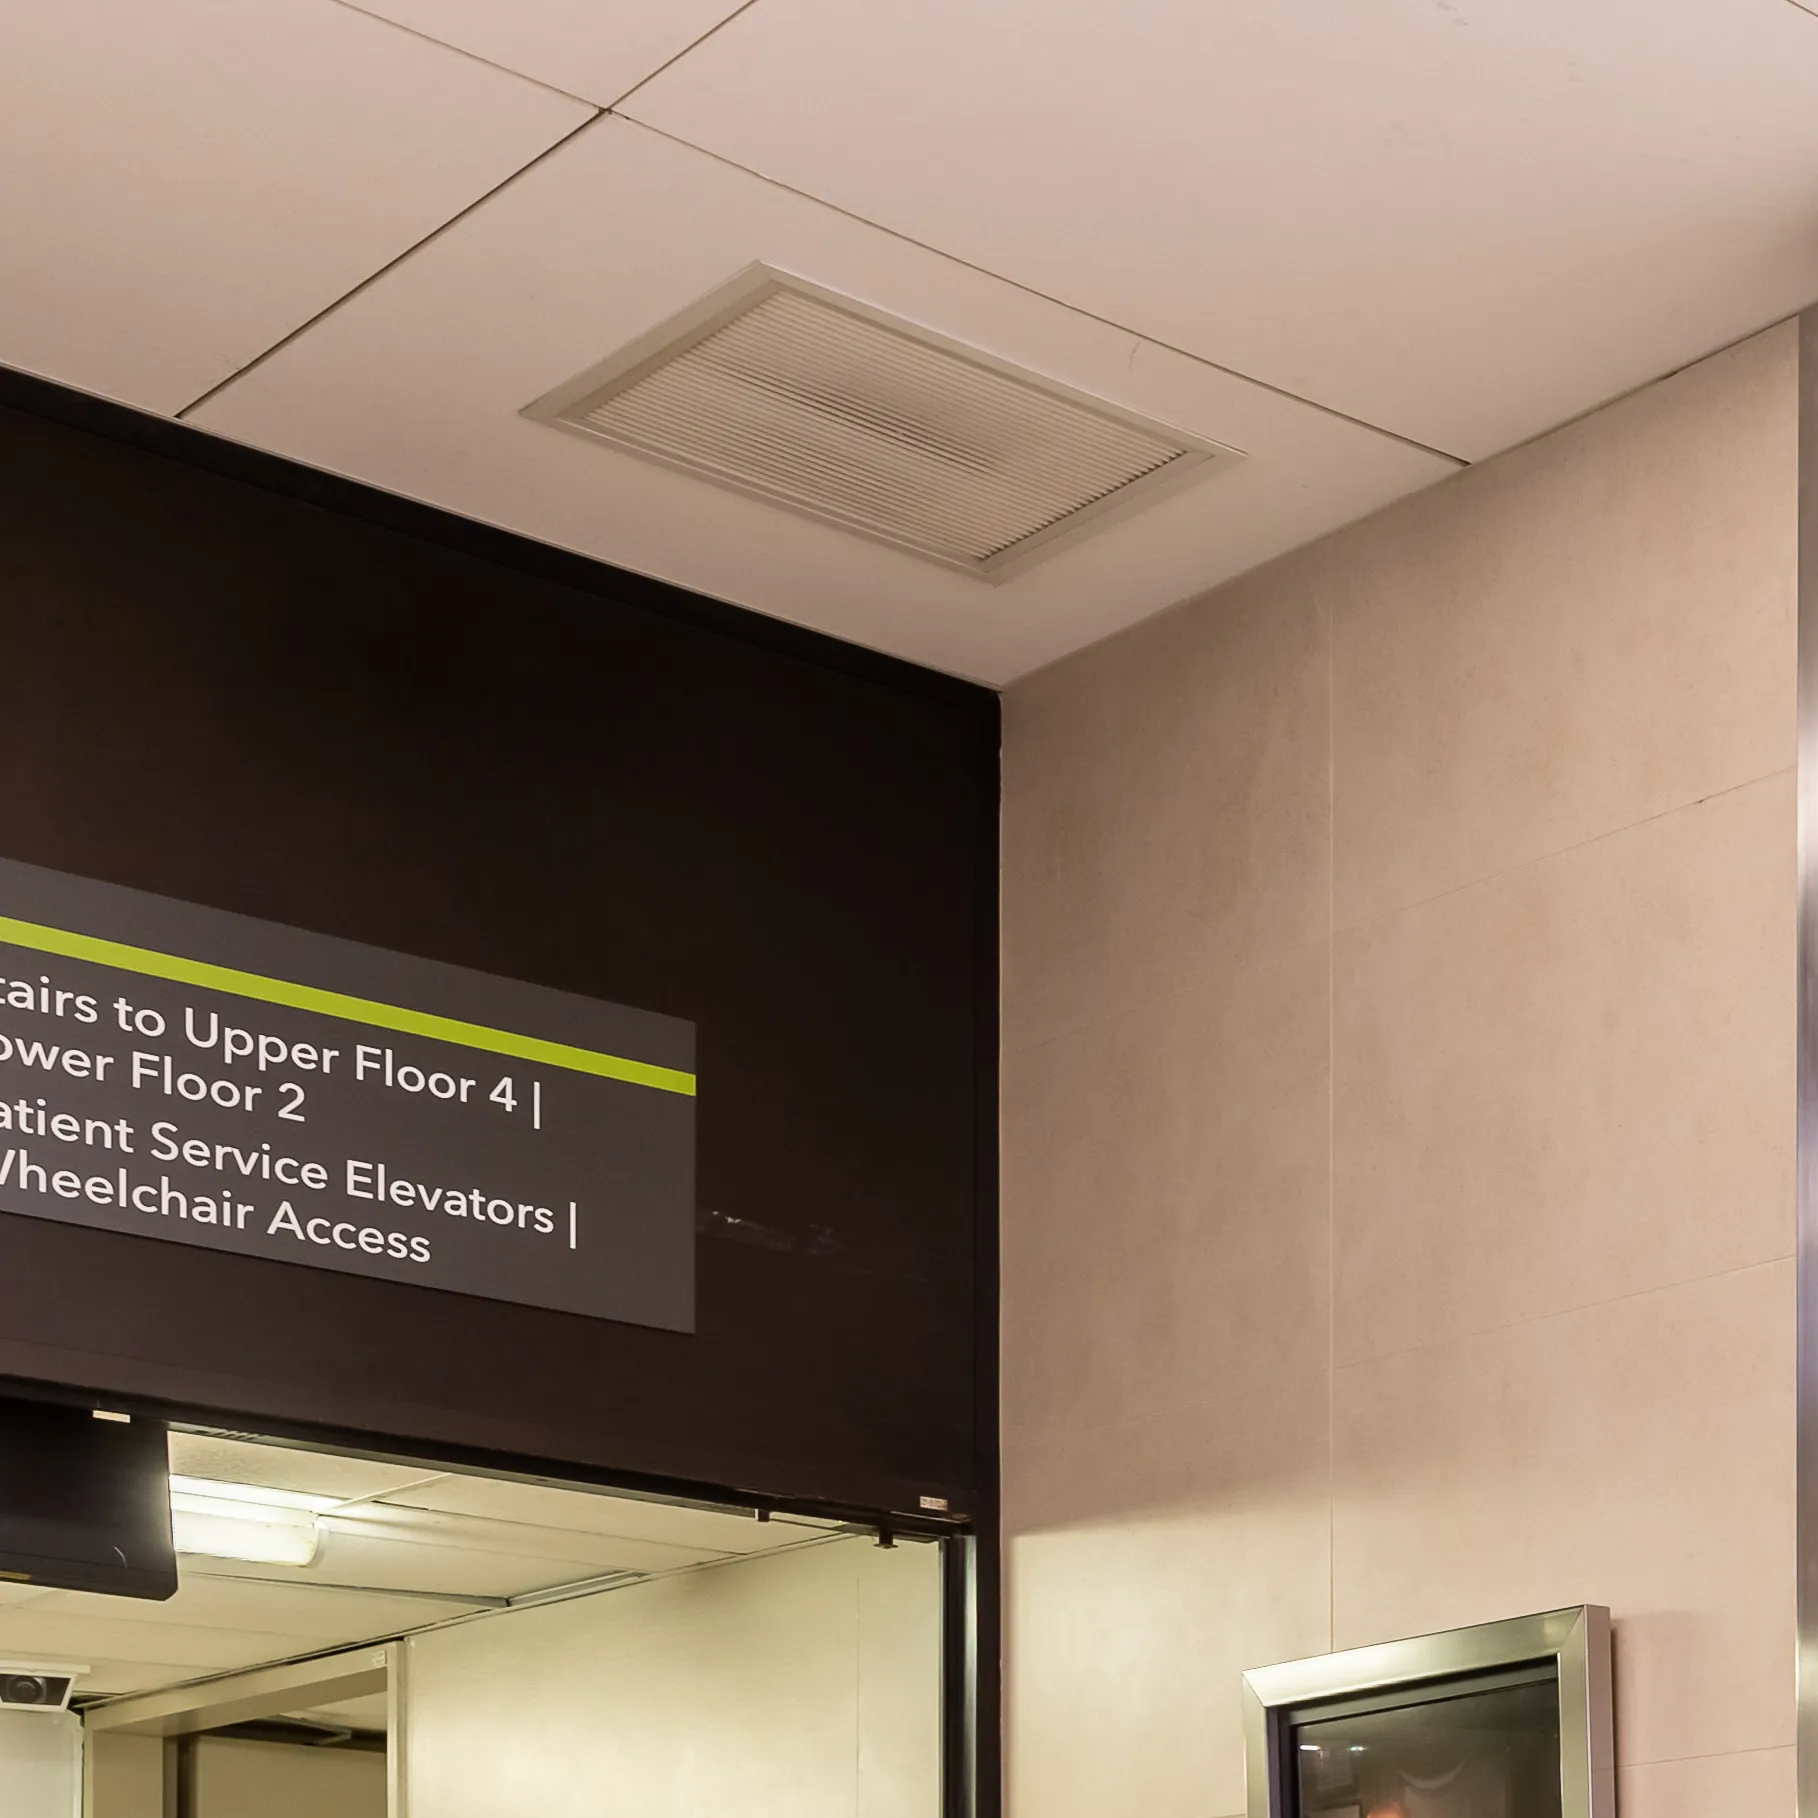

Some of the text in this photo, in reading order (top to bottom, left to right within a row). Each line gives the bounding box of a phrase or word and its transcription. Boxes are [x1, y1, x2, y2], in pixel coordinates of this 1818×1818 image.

[113, 998, 165, 1036] to
[186, 1008, 339, 1073] Upper
[357, 1045, 476, 1102] Floor
[490, 1077, 517, 1111] 4
[133, 1051, 262, 1111] Floor
[279, 1083, 304, 1121] 2
[151, 1122, 327, 1189] Service
[347, 1160, 553, 1233] Elevators
[267, 1201, 430, 1262] Access
